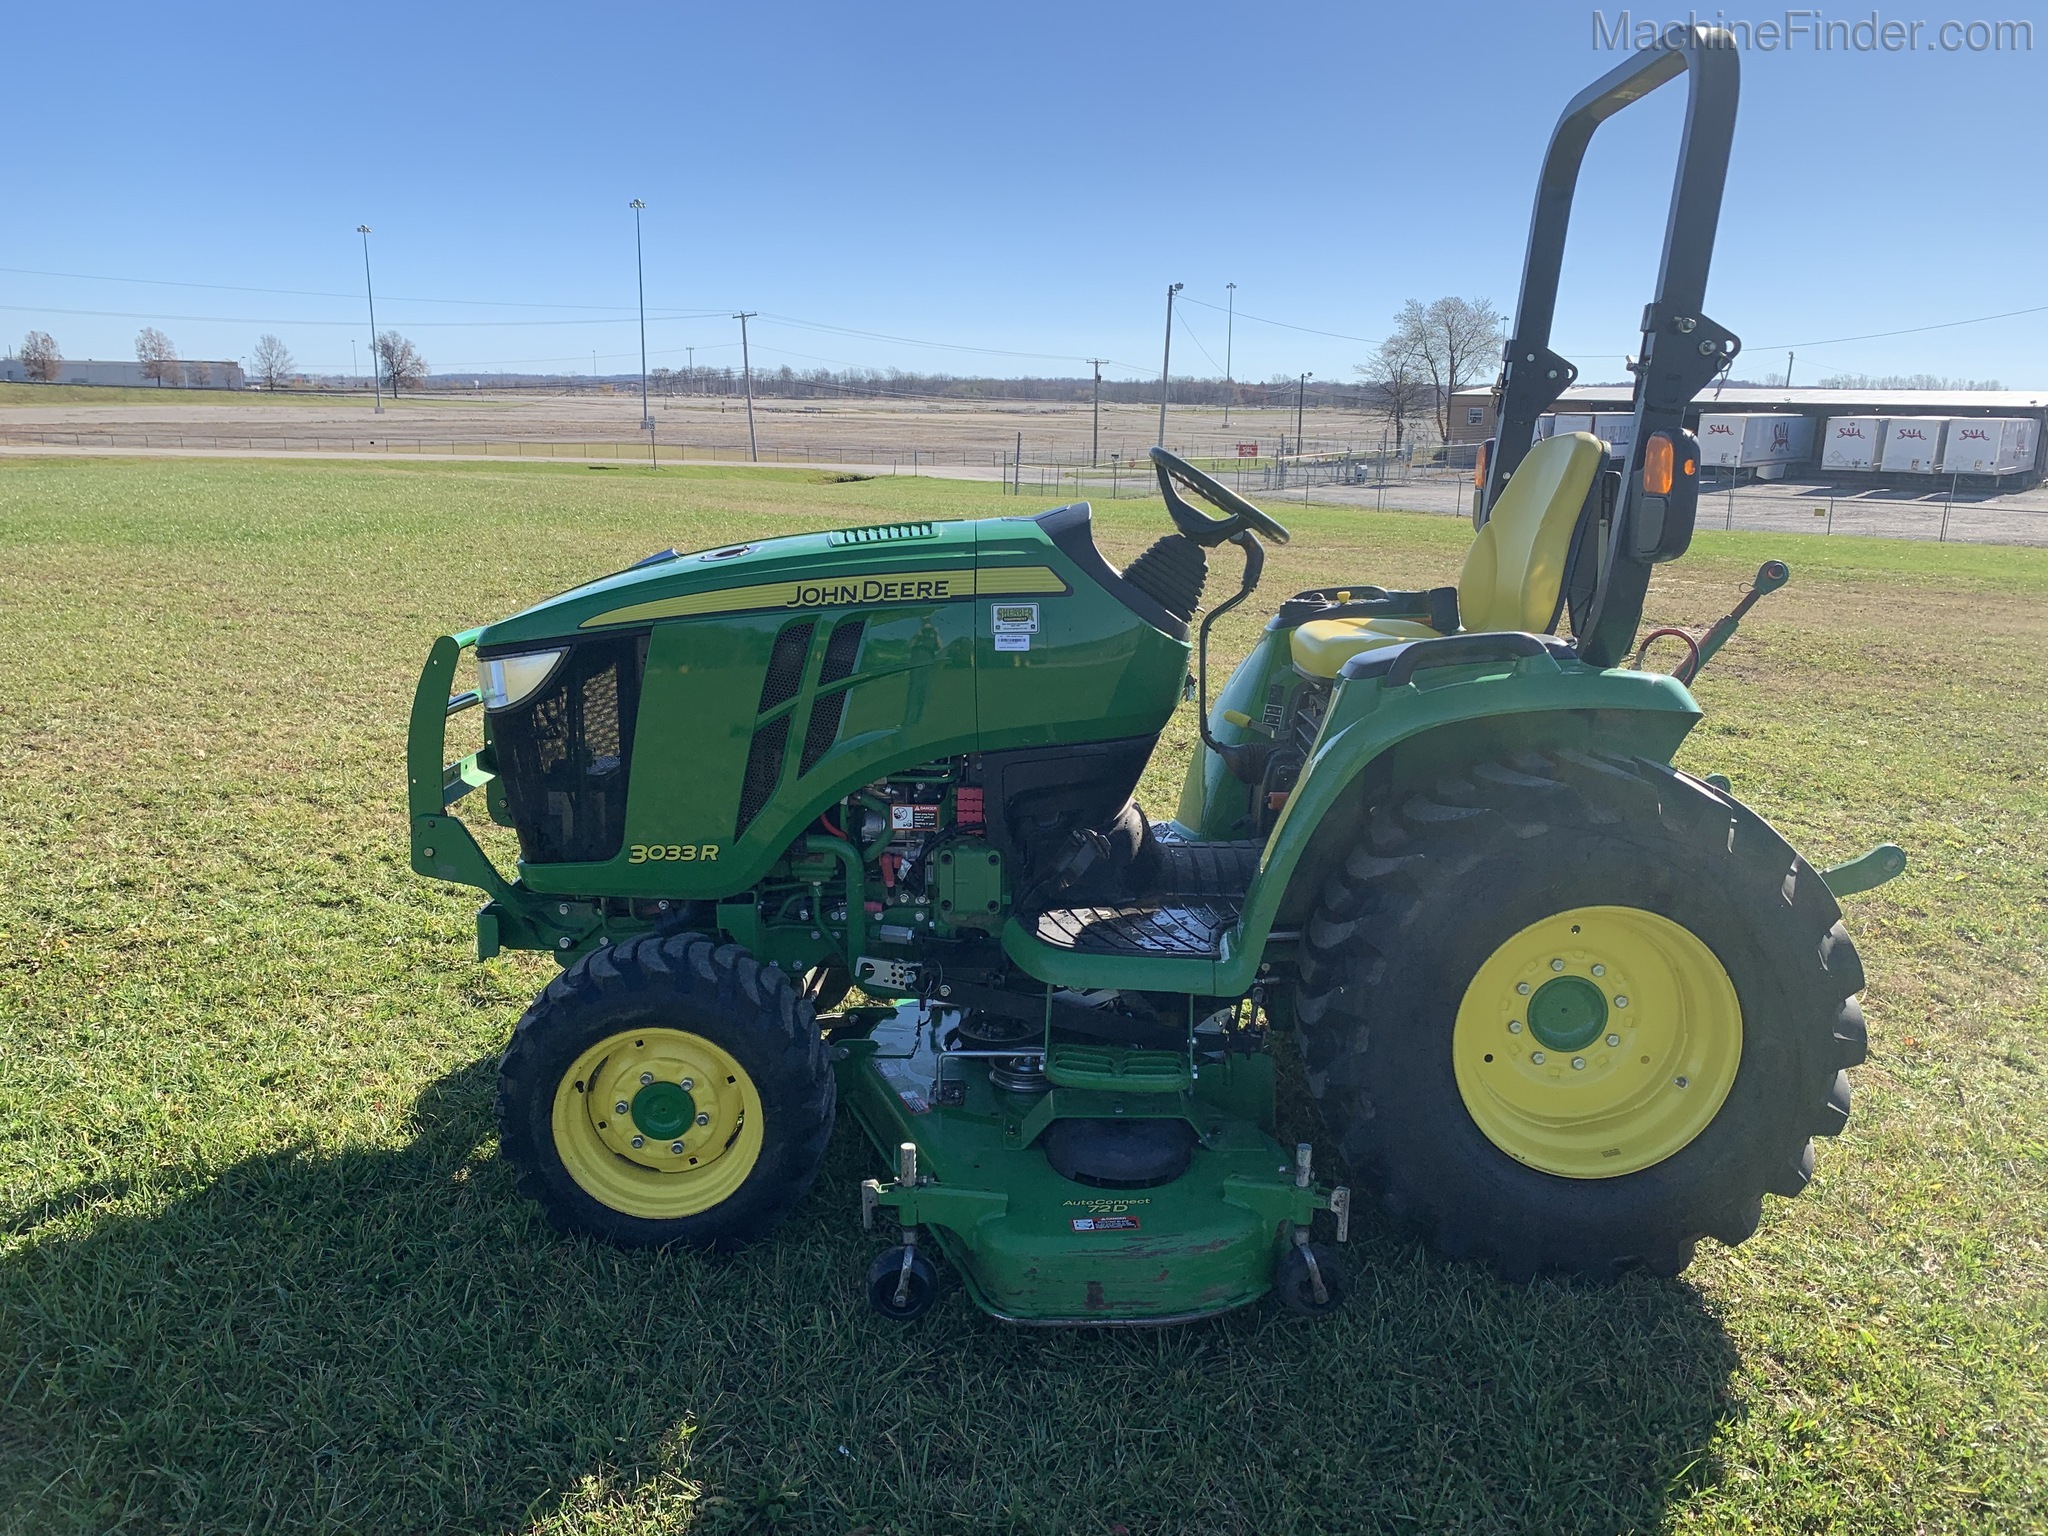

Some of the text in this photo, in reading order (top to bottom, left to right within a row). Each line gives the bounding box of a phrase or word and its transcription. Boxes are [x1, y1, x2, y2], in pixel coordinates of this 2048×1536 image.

[1707, 424, 1735, 436] SAIA
[1836, 427, 1866, 439] SAIA
[1896, 428, 1927, 440] SAIA
[1958, 428, 1991, 441] SAIA
[786, 580, 950, 606] JOHN DEERE
